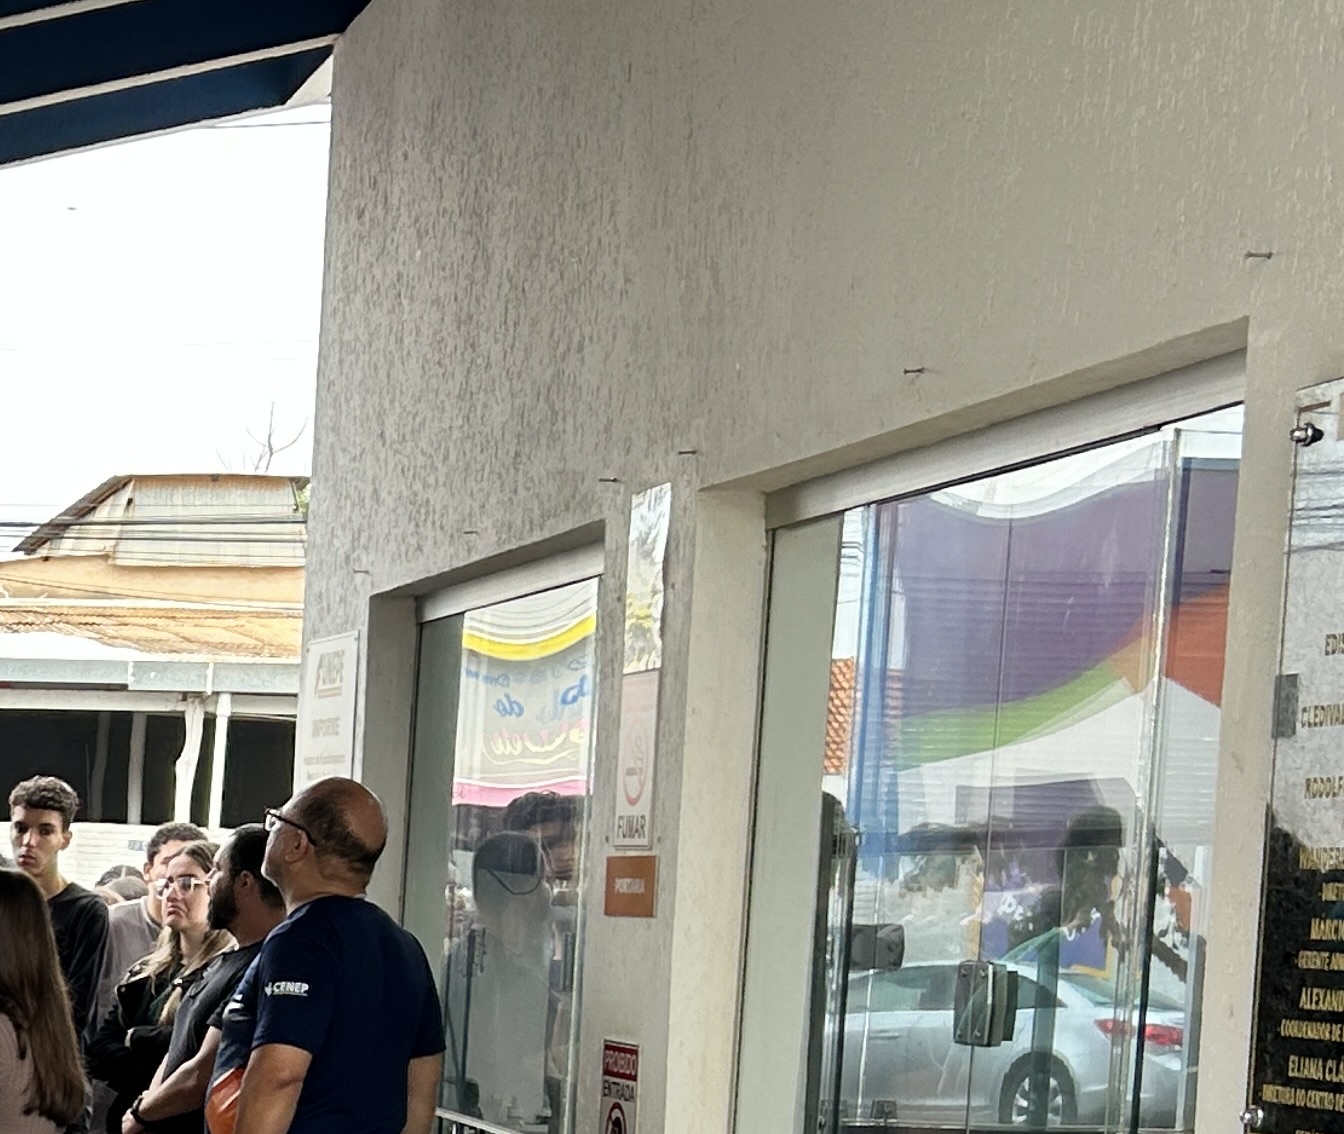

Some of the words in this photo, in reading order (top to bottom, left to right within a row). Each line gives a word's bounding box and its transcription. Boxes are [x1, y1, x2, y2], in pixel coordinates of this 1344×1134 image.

[617, 815, 647, 839] FUMAR
[273, 981, 309, 993] CENEP
[605, 1050, 636, 1075] PROIBIDO
[1288, 1054, 1323, 1080] ELIANA
[603, 1079, 635, 1101] ENTRADA
[1306, 1089, 1334, 1111] CENTRO
